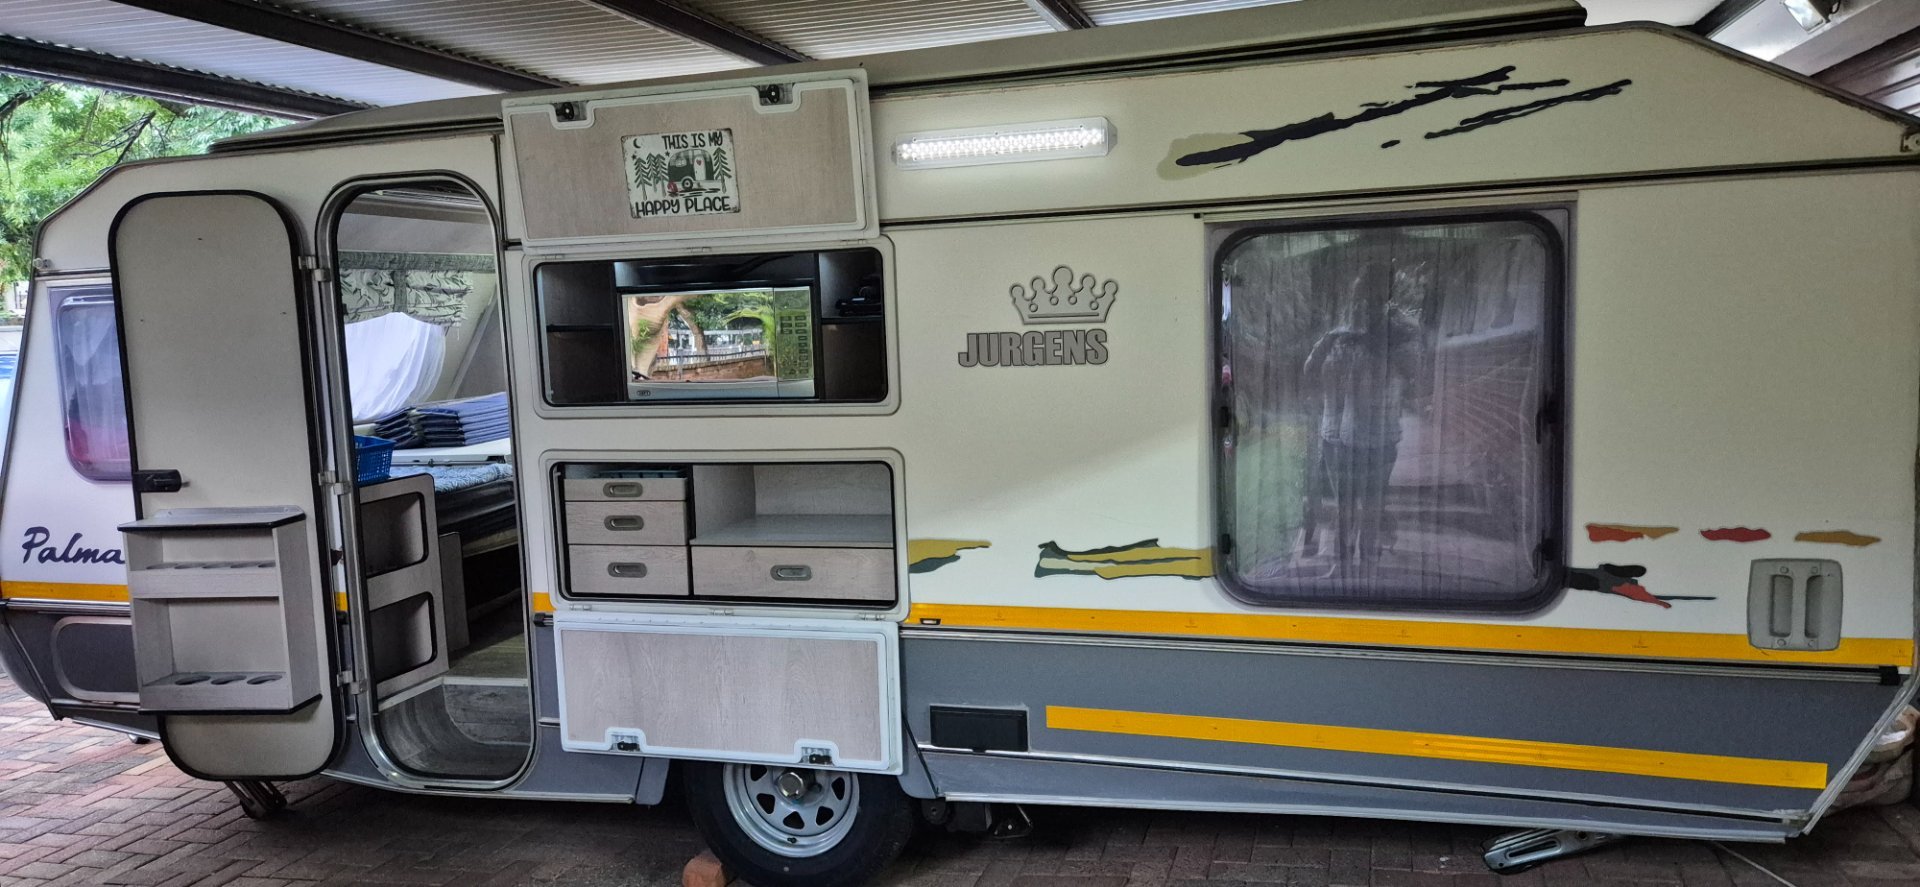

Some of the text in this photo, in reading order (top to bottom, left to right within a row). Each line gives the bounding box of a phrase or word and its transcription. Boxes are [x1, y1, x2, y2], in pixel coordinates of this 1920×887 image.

[661, 131, 723, 150] THIS IS MY
[635, 196, 731, 217] HAPPY PLACE
[958, 329, 1108, 367] JURGENS
[22, 526, 125, 564] Palma
